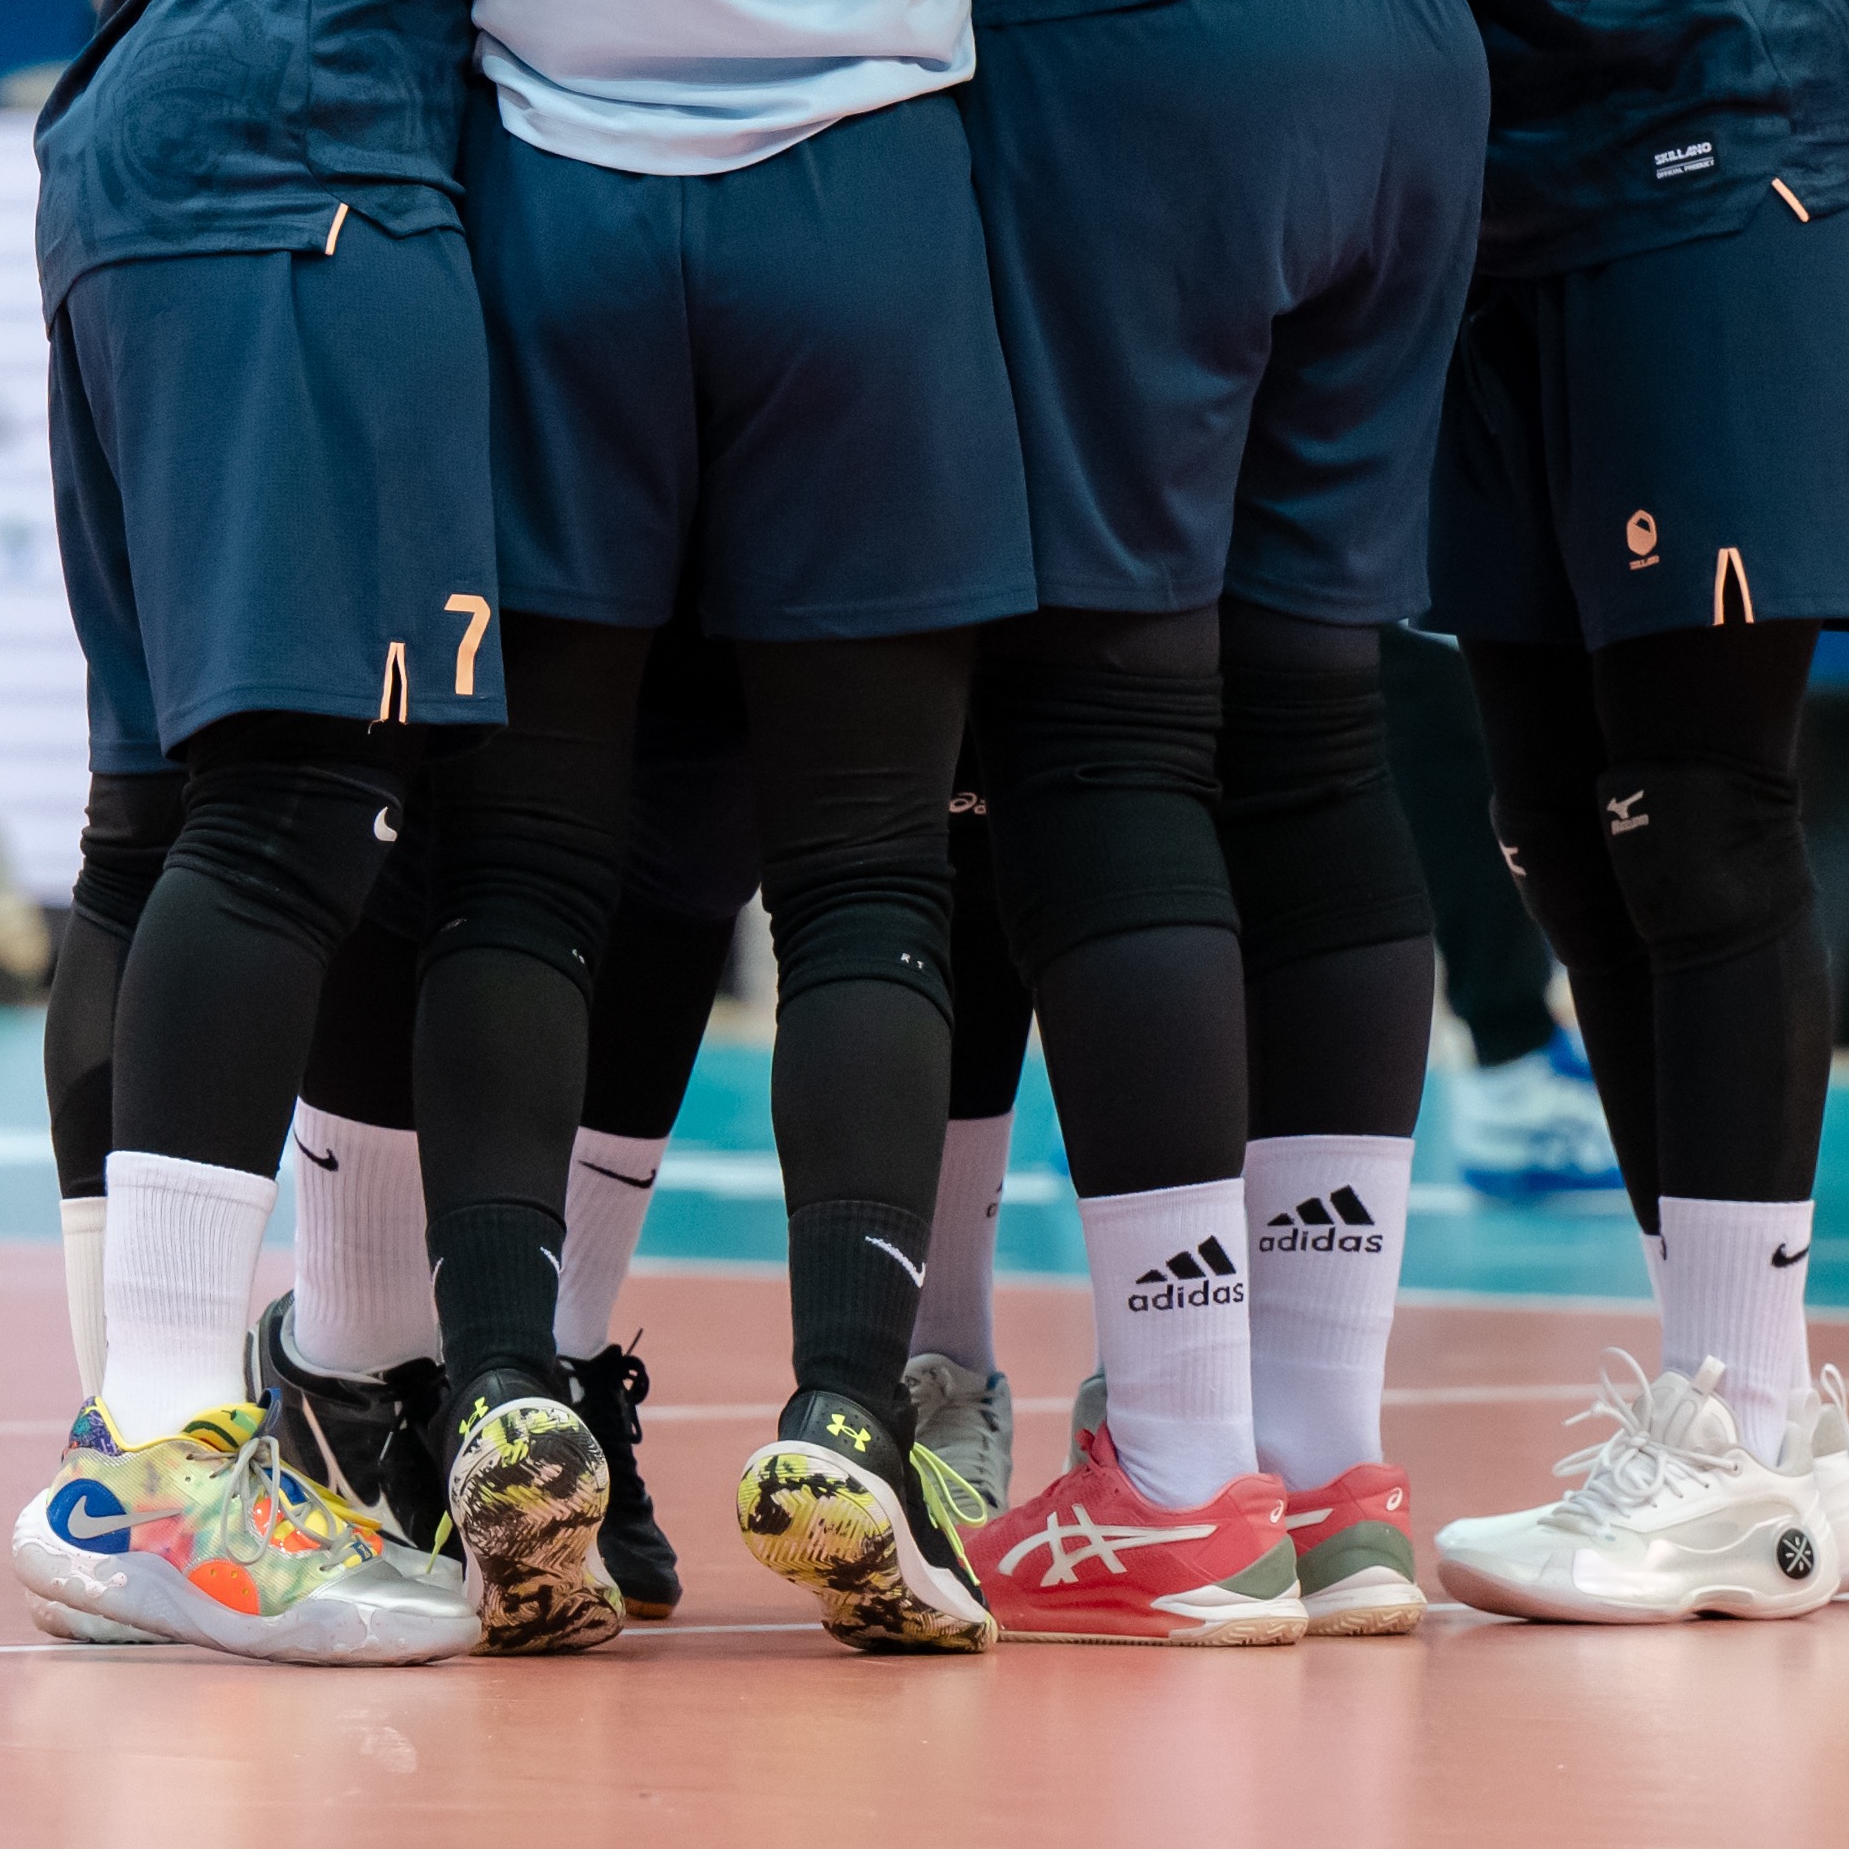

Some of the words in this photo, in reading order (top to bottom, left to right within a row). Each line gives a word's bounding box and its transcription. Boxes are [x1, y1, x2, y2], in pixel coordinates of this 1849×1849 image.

[1654, 141, 1713, 166] SKILLANO
[443, 593, 491, 696] 7
[1258, 1227, 1384, 1253] adidas
[1128, 1280, 1244, 1312] adidas
